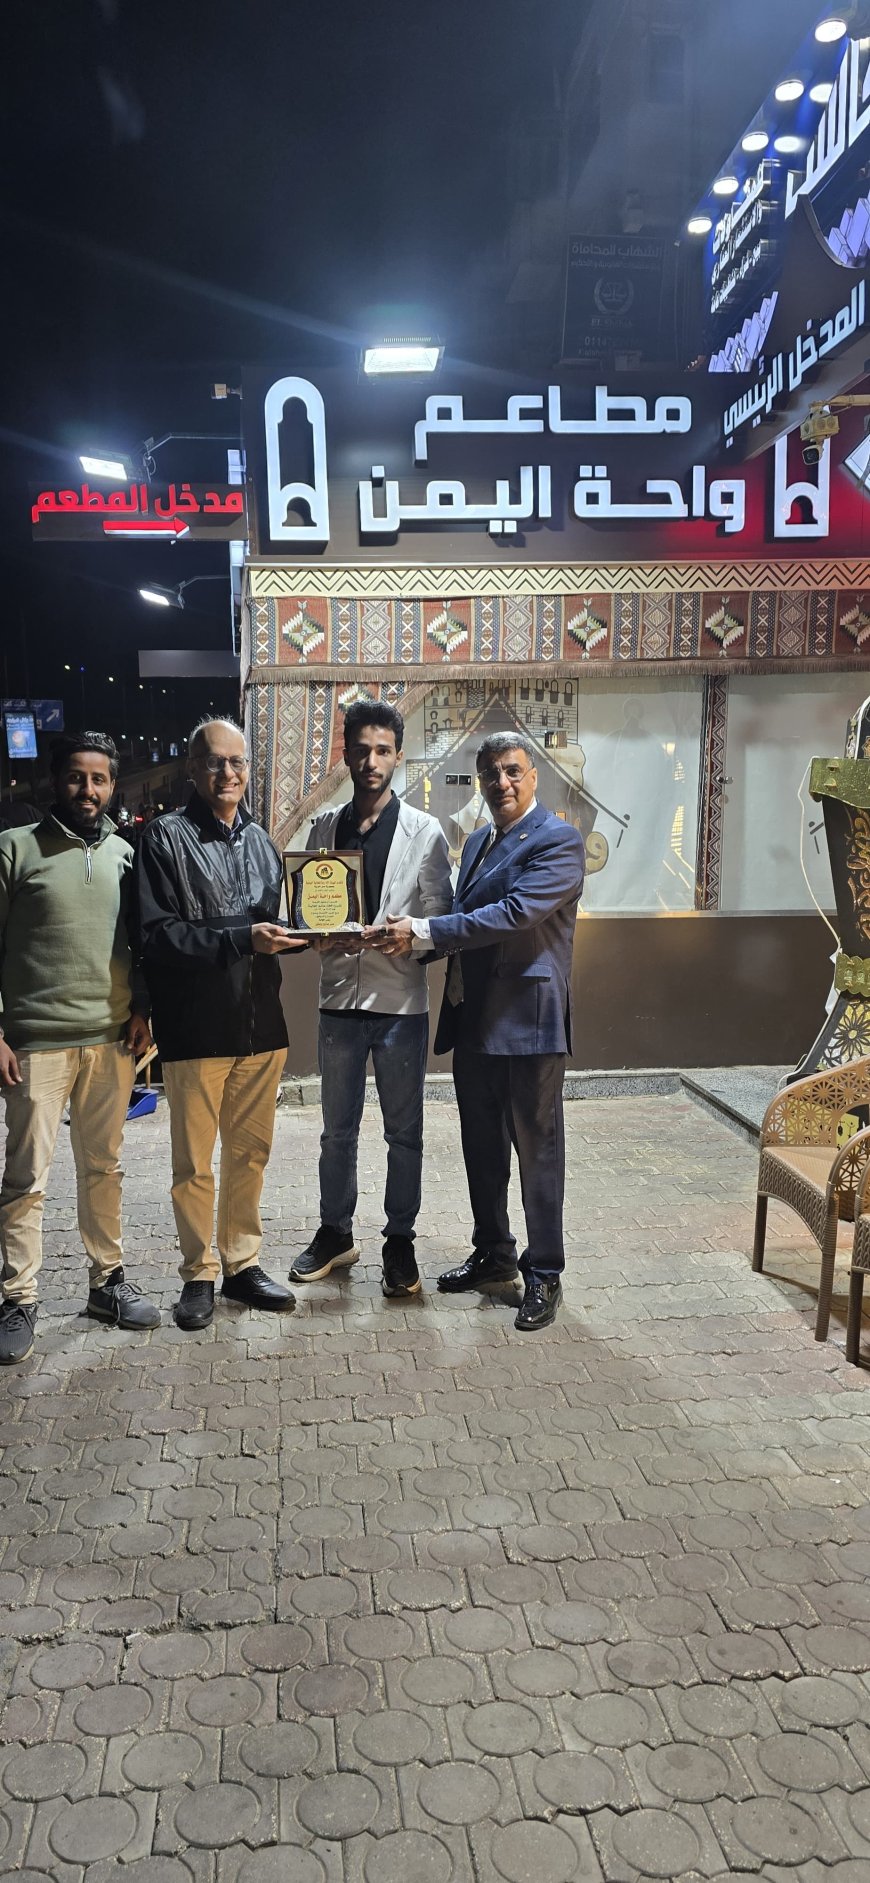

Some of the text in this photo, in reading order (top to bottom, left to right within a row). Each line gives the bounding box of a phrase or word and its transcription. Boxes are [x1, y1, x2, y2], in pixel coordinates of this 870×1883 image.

[571, 242, 662, 260] الشهاب للمحاماة
[723, 279, 866, 448] المدخل الرئيسي
[414, 385, 692, 460] مطاعم
[31, 484, 243, 523] مدخل المطعم
[358, 465, 746, 533] واحة اليمن
